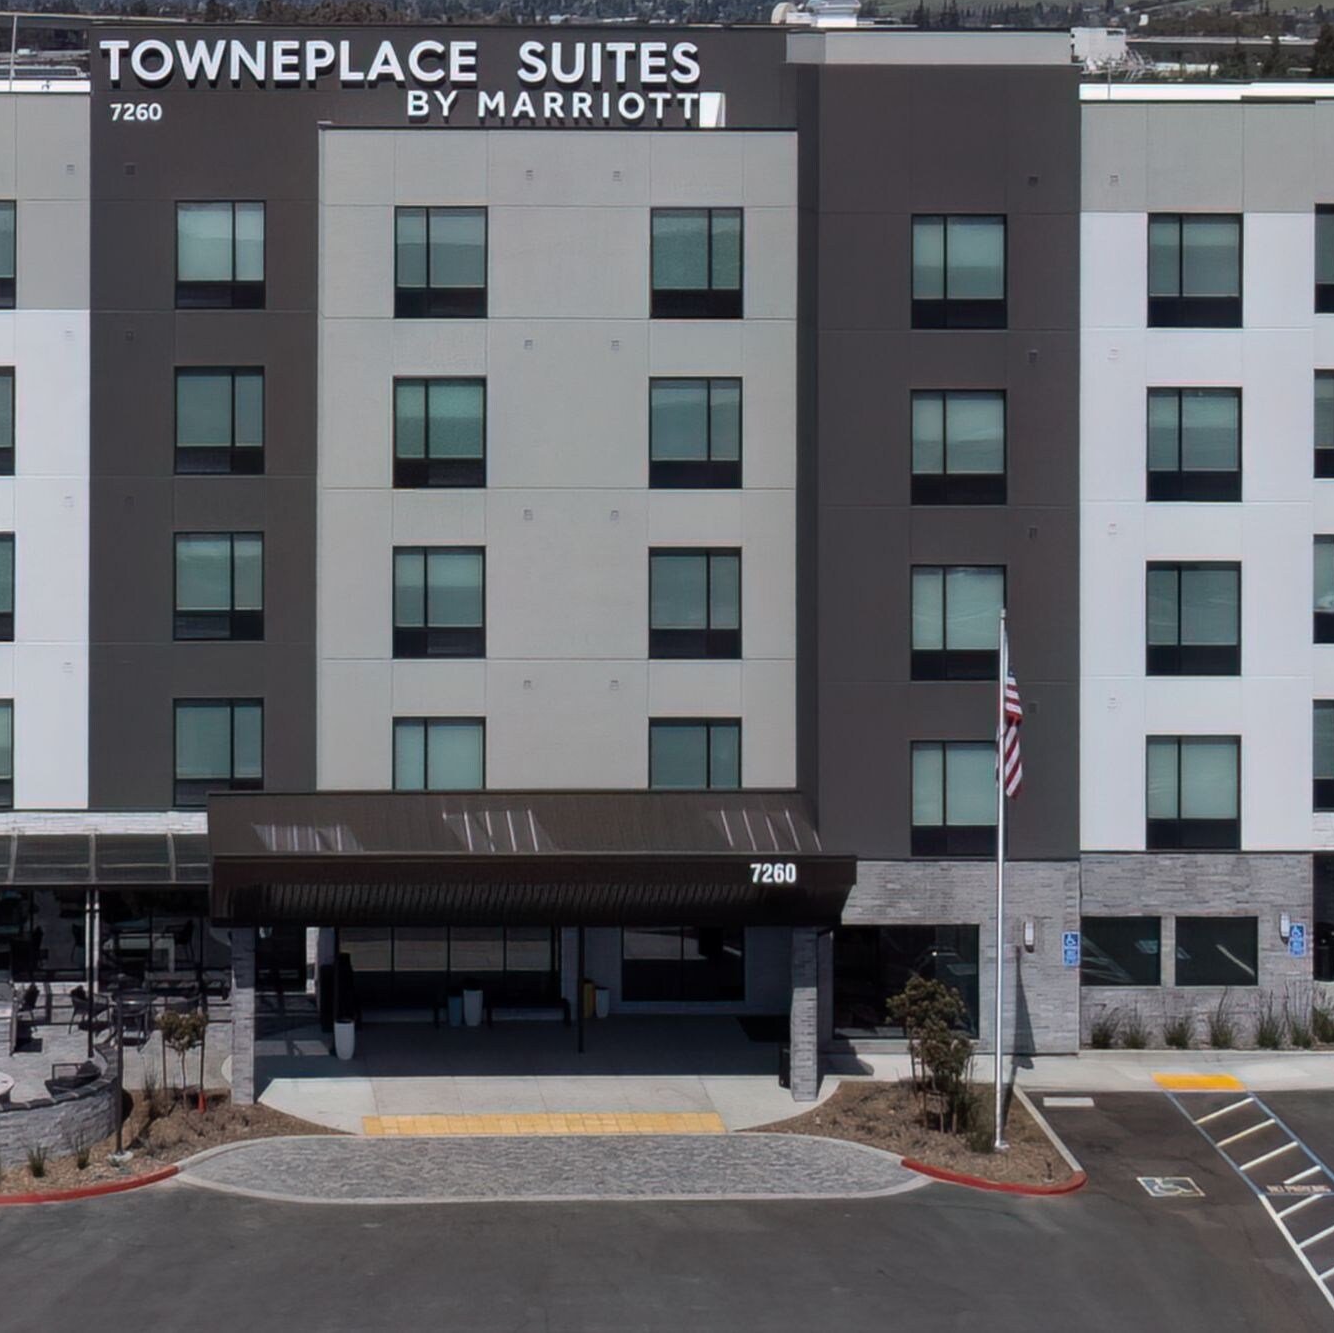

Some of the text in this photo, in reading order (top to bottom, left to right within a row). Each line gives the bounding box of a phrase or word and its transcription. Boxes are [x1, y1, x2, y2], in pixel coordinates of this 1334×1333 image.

[99, 39, 701, 84] TOWNEPLACE SUITES
[110, 102, 163, 121] 7260
[407, 90, 699, 119] BY MARRIOTT
[750, 862, 797, 883] 7260
